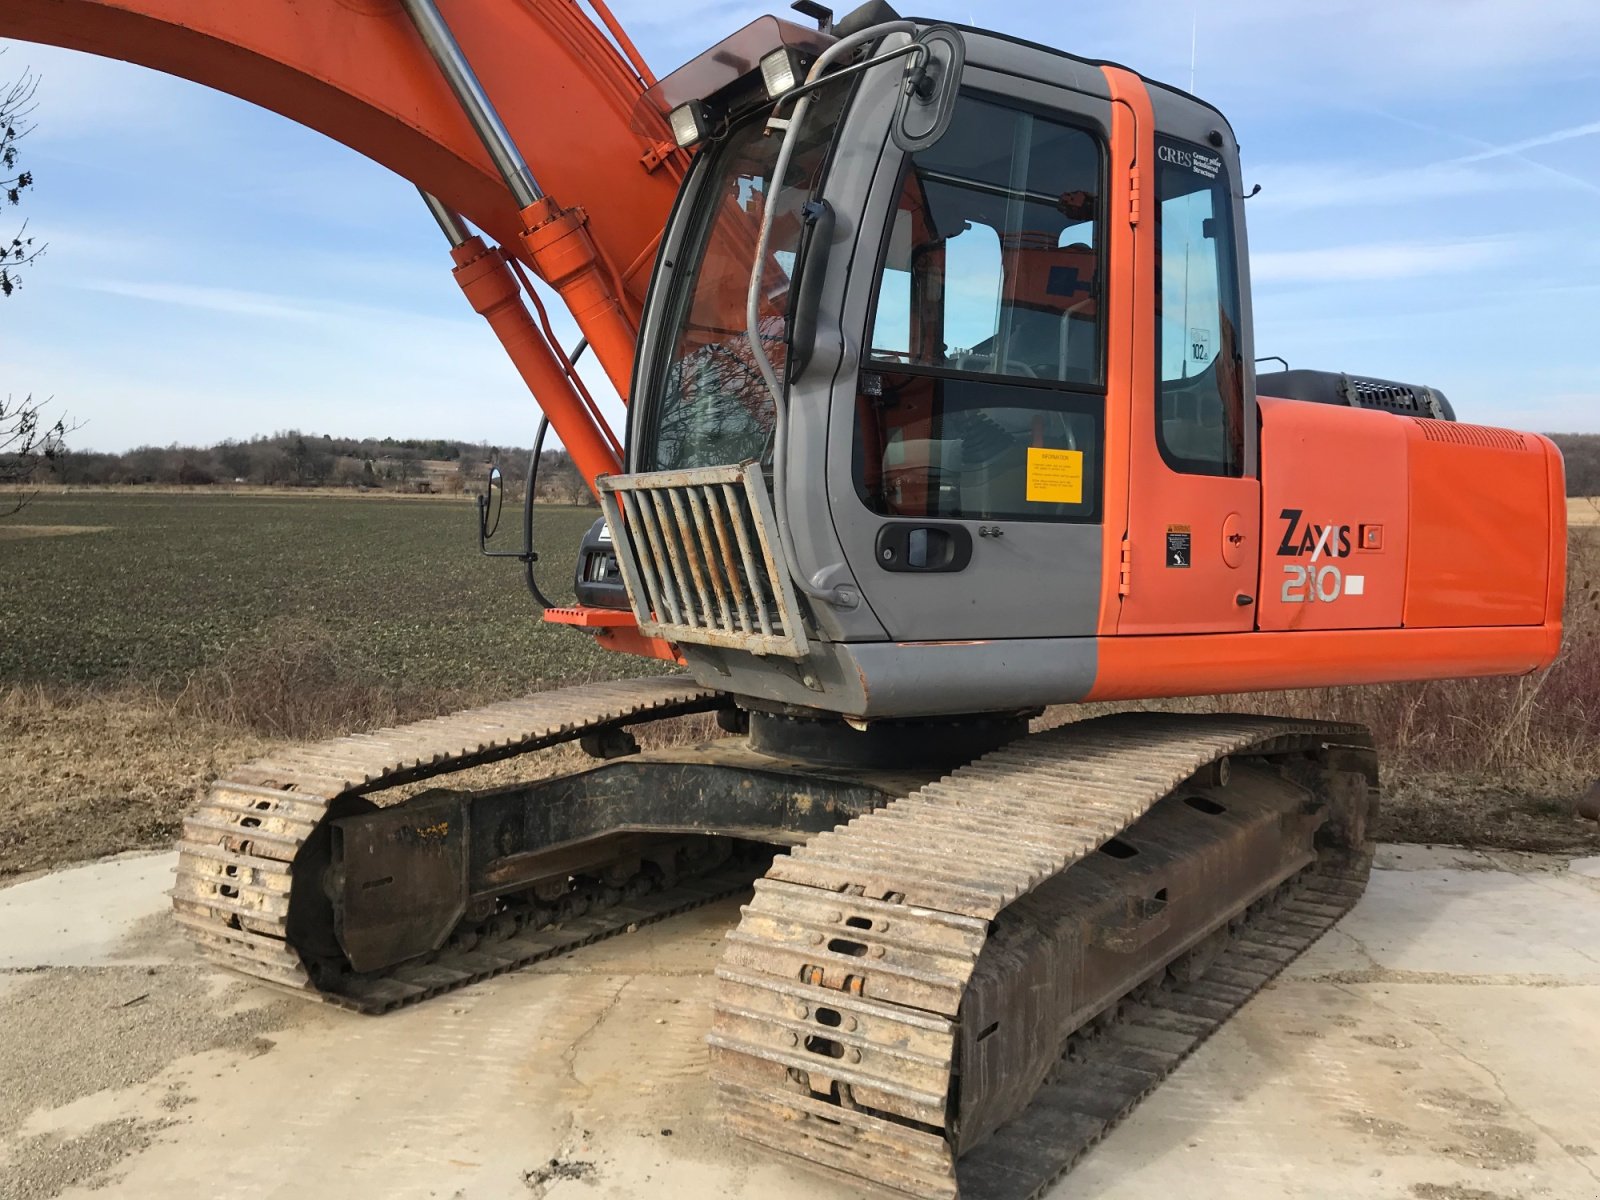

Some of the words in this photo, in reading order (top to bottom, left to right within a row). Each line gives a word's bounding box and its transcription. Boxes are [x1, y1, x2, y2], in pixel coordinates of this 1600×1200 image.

[1157, 145, 1192, 168] CRES
[1192, 343, 1204, 360] 102
[1281, 564, 1342, 603] 210
